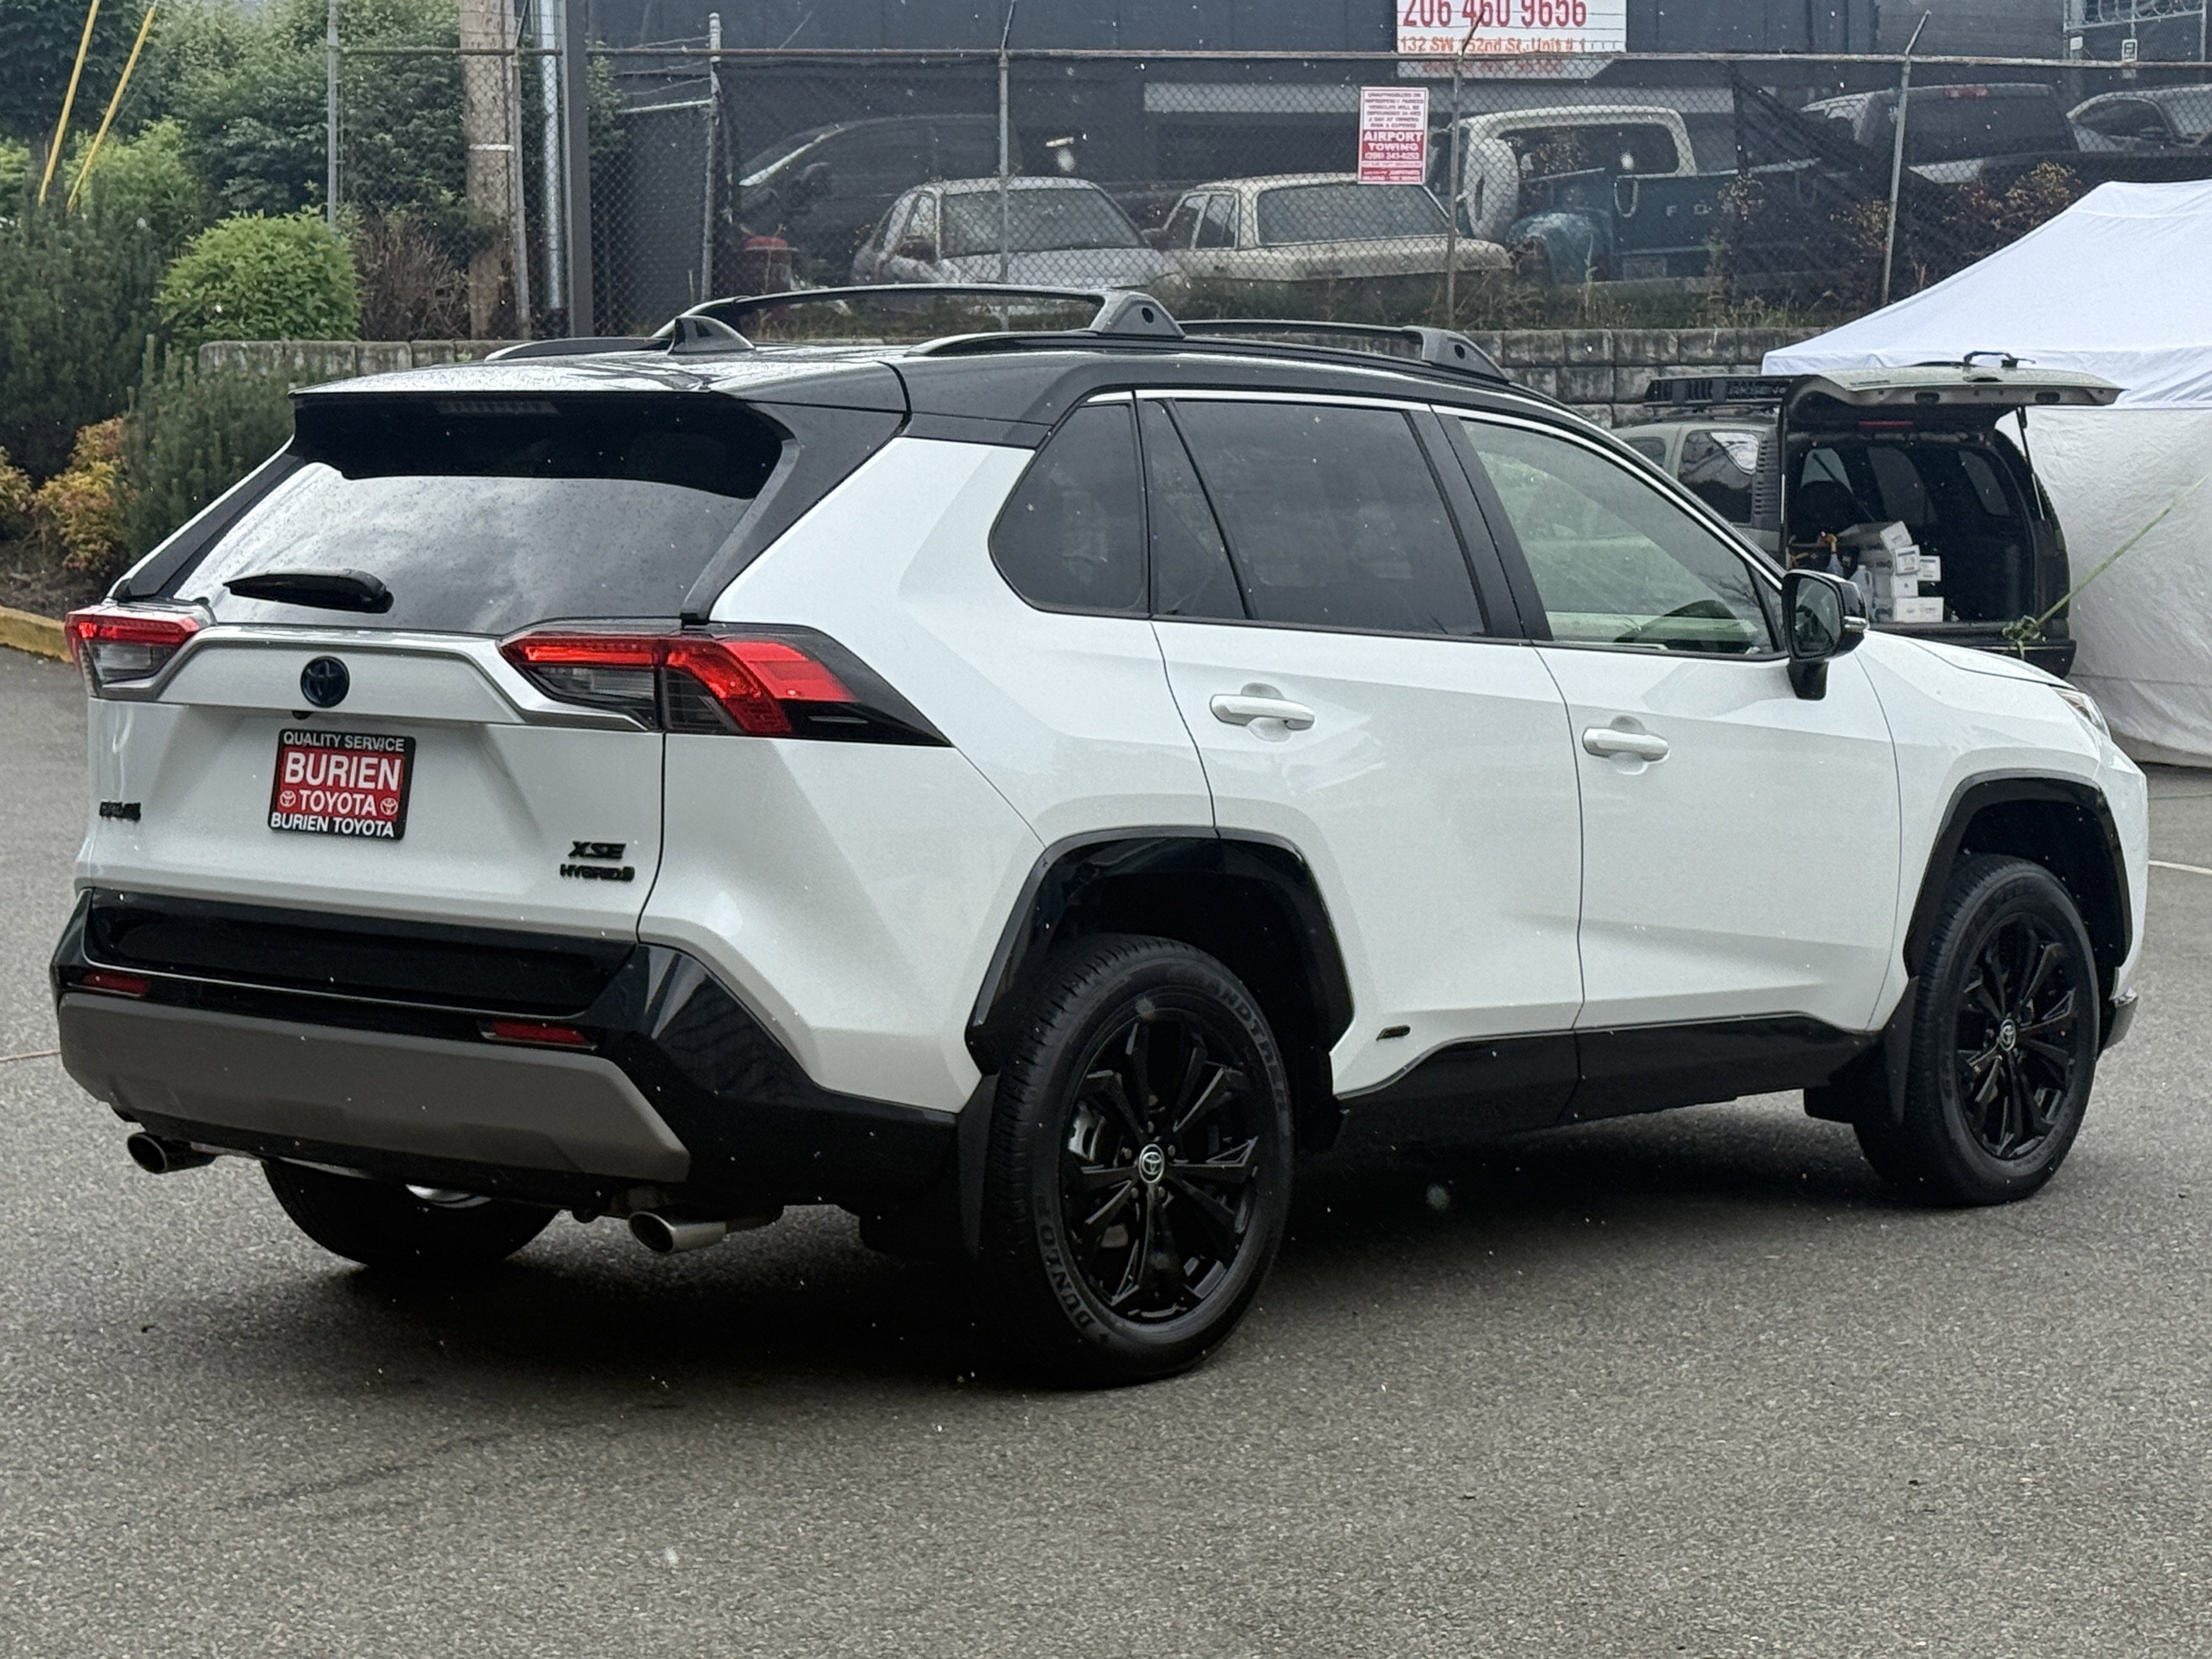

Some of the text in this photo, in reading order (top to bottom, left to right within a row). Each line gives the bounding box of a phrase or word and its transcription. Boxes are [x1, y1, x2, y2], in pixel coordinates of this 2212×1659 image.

[1403, 0, 1586, 27] 206 460 9656
[1401, 36, 1426, 52] 132
[1430, 36, 1454, 52] SW
[1462, 37, 1502, 52] 52nd
[1364, 131, 1423, 142] AIRPORT
[1368, 143, 1419, 151] TOWING
[284, 731, 405, 753] QUALITY SERVICE
[285, 752, 402, 791] BURIEN
[299, 789, 377, 816] TOYOTA
[270, 812, 394, 838] BURIEN TOYOTA
